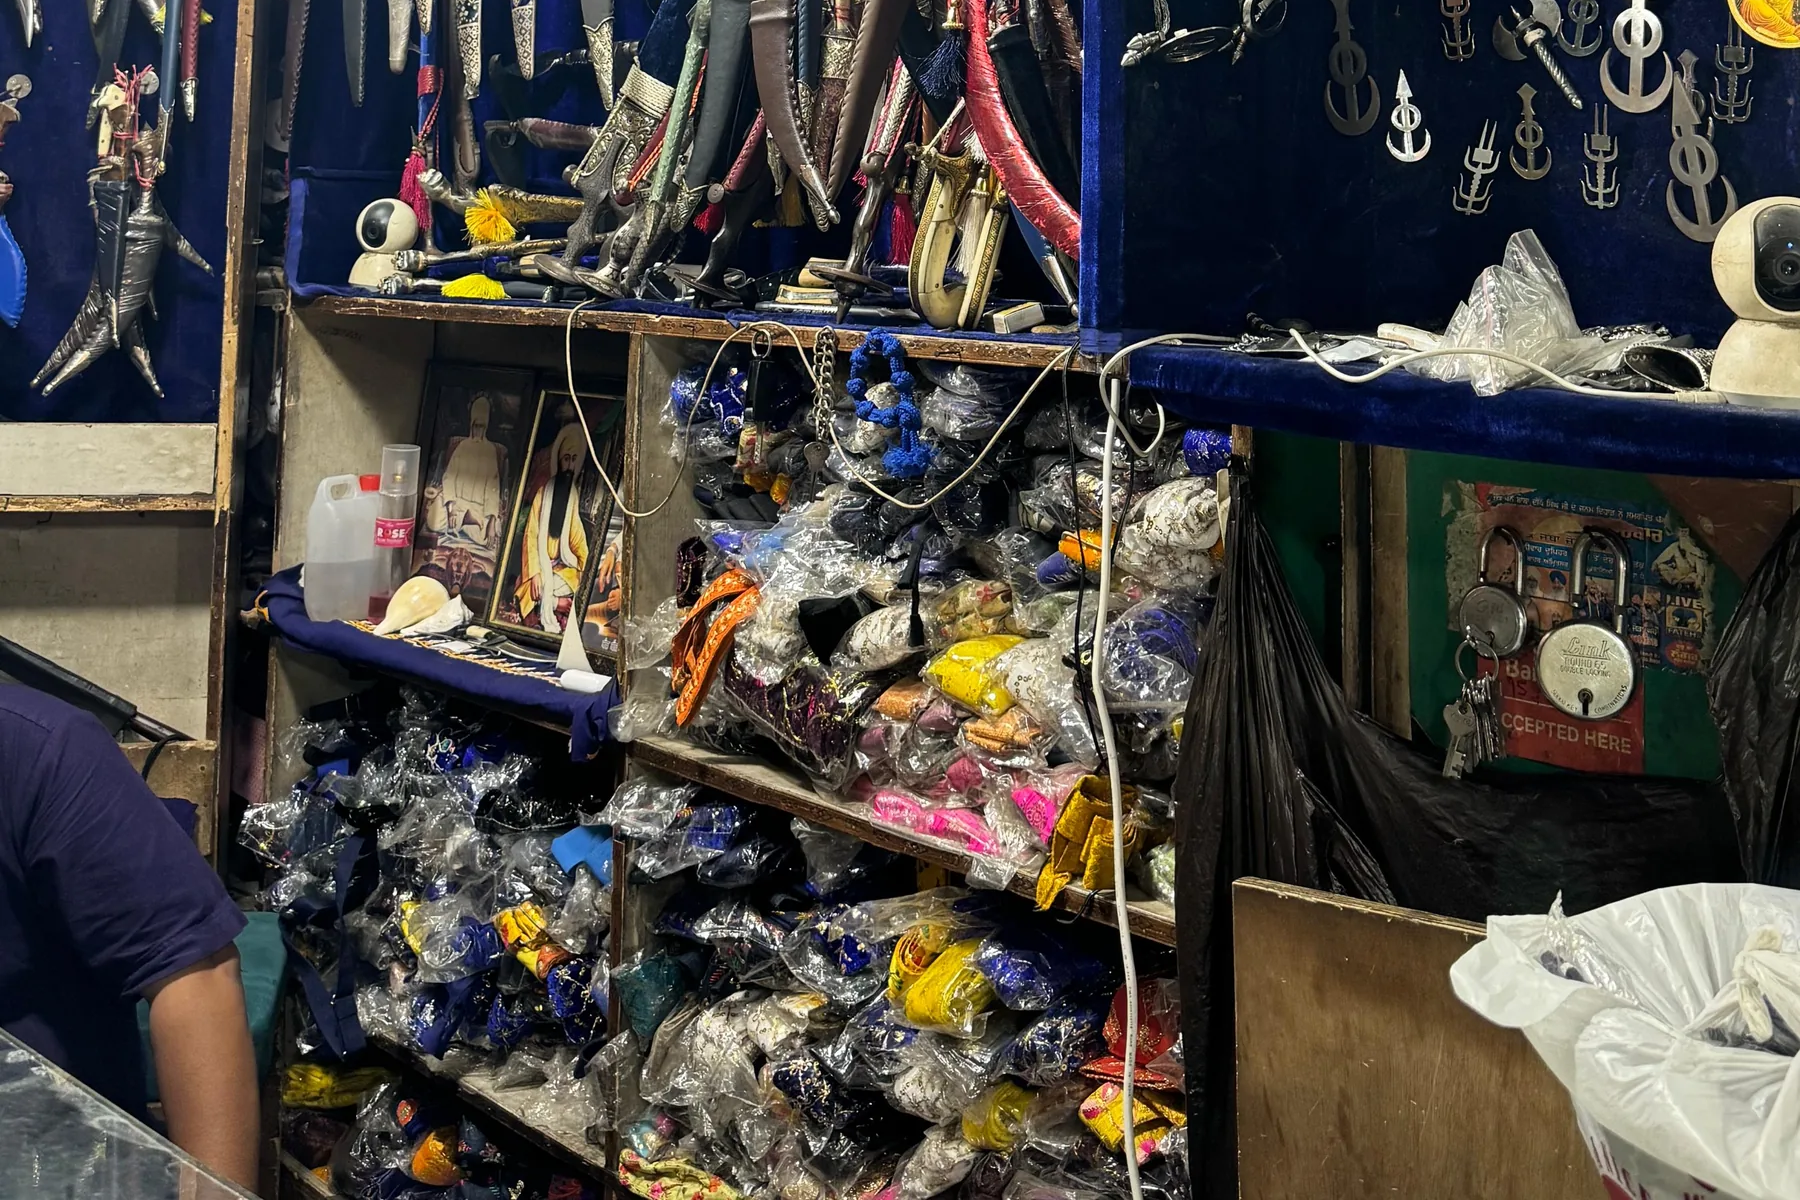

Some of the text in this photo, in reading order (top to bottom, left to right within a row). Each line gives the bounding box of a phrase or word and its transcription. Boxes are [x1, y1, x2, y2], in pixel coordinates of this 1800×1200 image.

[377, 527, 406, 539] ROSE
[1666, 594, 1702, 610] LIVE
[1594, 660, 1607, 670] 65
[1501, 712, 1632, 754] CCEPTED HERE
